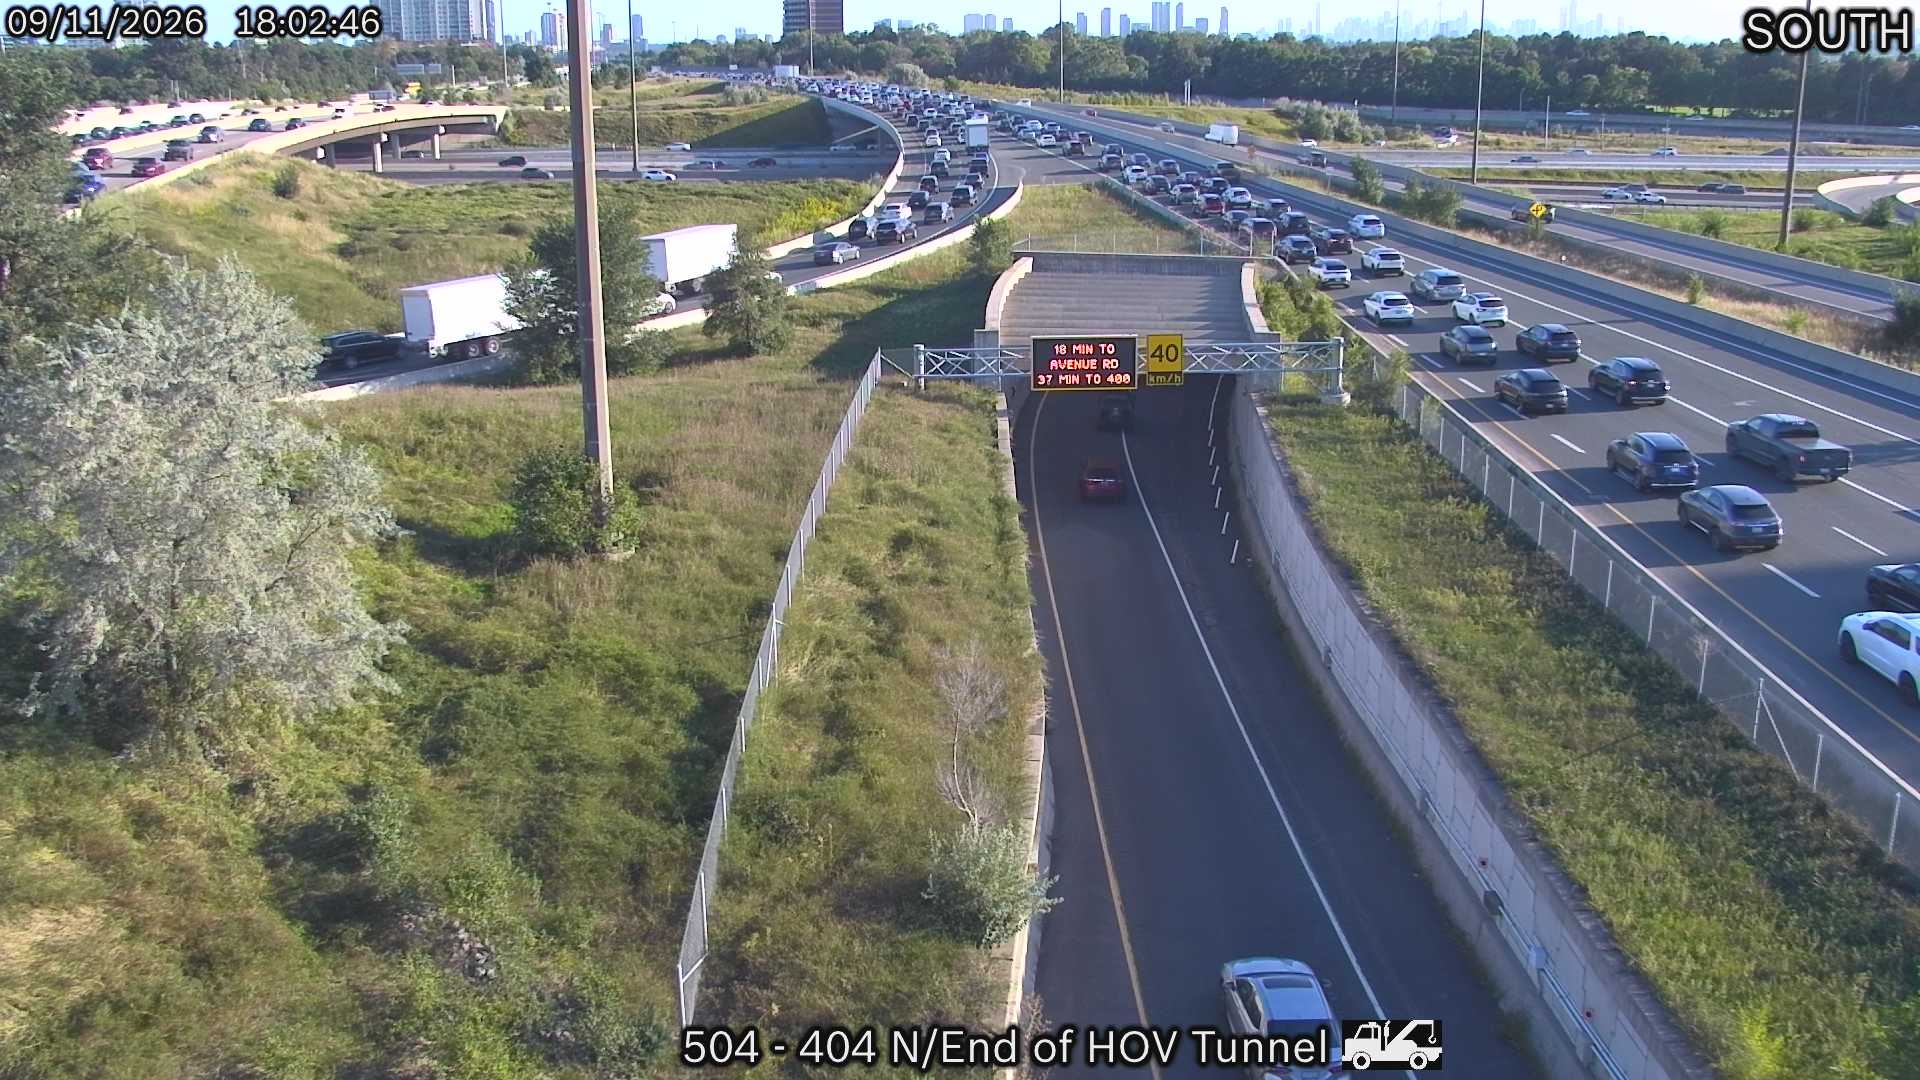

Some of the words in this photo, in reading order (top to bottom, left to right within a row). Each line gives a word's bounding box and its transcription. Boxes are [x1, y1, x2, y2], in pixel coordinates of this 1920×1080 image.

[1072, 343, 1094, 355] MIN
[1099, 343, 1116, 355] TO
[1150, 343, 1180, 363] 40
[1049, 359, 1098, 371] AVENUE
[1102, 358, 1119, 370] RD
[1037, 374, 1052, 385] 37
[1058, 374, 1080, 385] MIN
[1085, 374, 1101, 385] TO
[1106, 373, 1131, 385] 400
[1150, 374, 1182, 384] km/h
